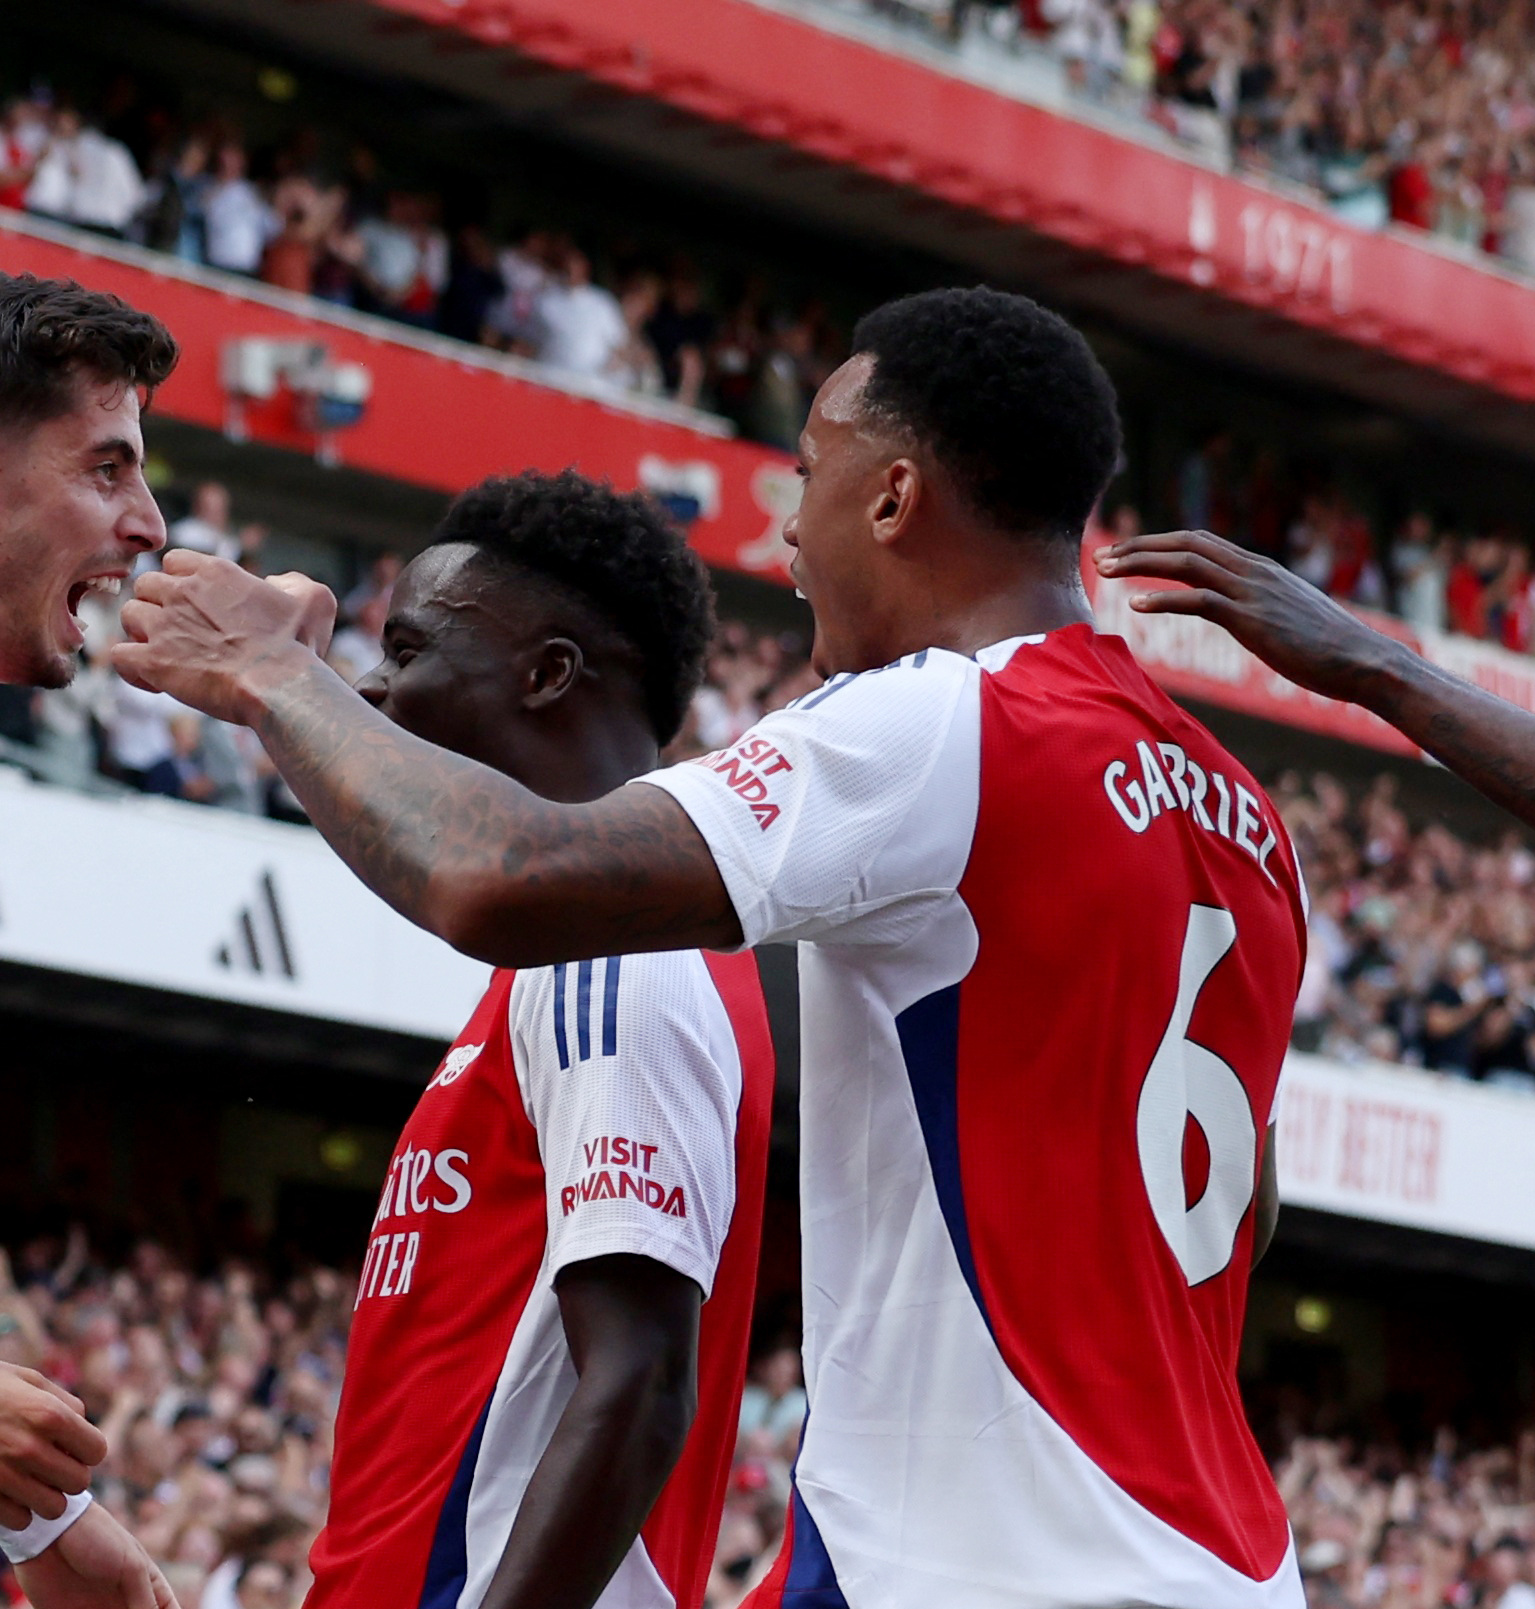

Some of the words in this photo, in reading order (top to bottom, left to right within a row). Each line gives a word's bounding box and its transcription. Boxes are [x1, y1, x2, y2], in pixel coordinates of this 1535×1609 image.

[1102, 739, 1279, 888] GABRIEL
[1136, 902, 1257, 1287] 6
[561, 1170, 687, 1219] RWANDA
[583, 1136, 659, 1174] VISIT
